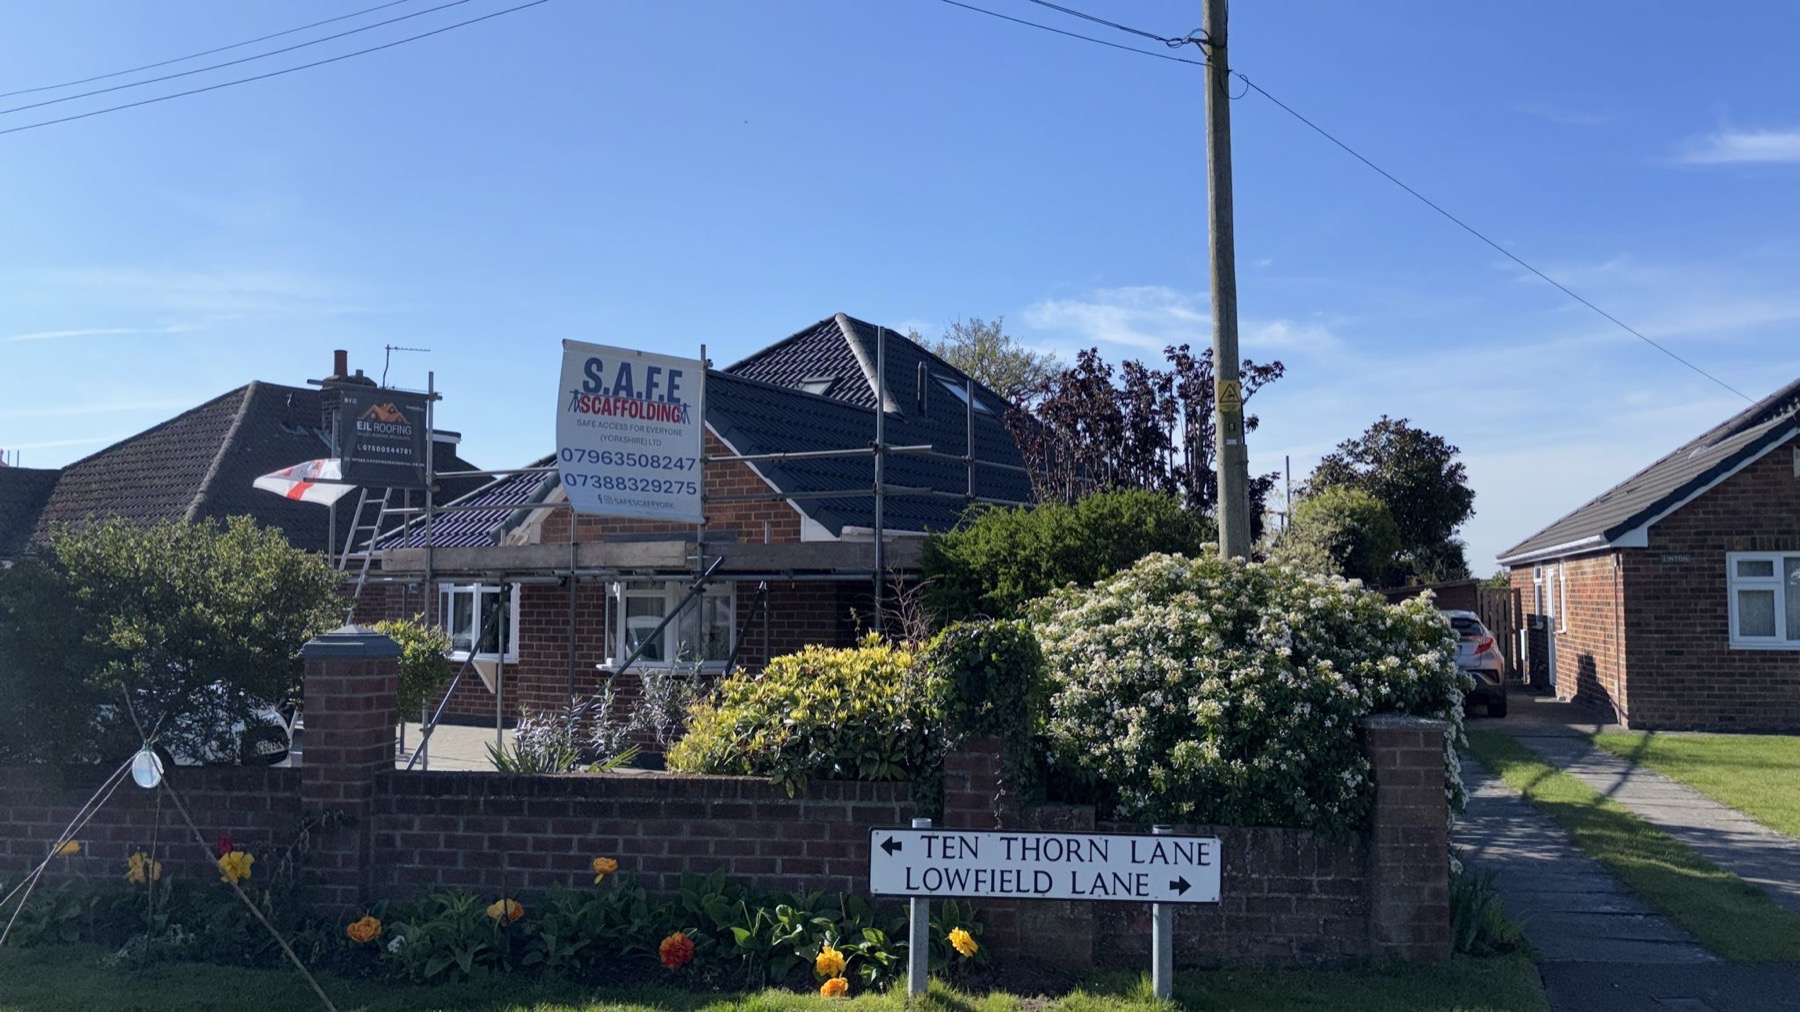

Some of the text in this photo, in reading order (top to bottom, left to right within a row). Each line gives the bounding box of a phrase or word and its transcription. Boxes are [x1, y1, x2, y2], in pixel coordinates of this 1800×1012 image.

[582, 357, 683, 404] S.A.F.E
[580, 393, 681, 424] SCAFFOLDING
[356, 420, 372, 431] EJL
[373, 422, 412, 436] ROOFING
[576, 418, 683, 436] SAFE ACCESS FOR EVERYONE
[600, 434, 662, 447] (YORKSHIRE) LTD
[561, 447, 696, 471] 07963508247
[564, 473, 697, 495] 07388329275
[613, 498, 675, 510] SAFESCAFFYORK
[920, 834, 1212, 867] TEN THORN LANE
[905, 866, 1150, 897] LOWFIELD LANE
